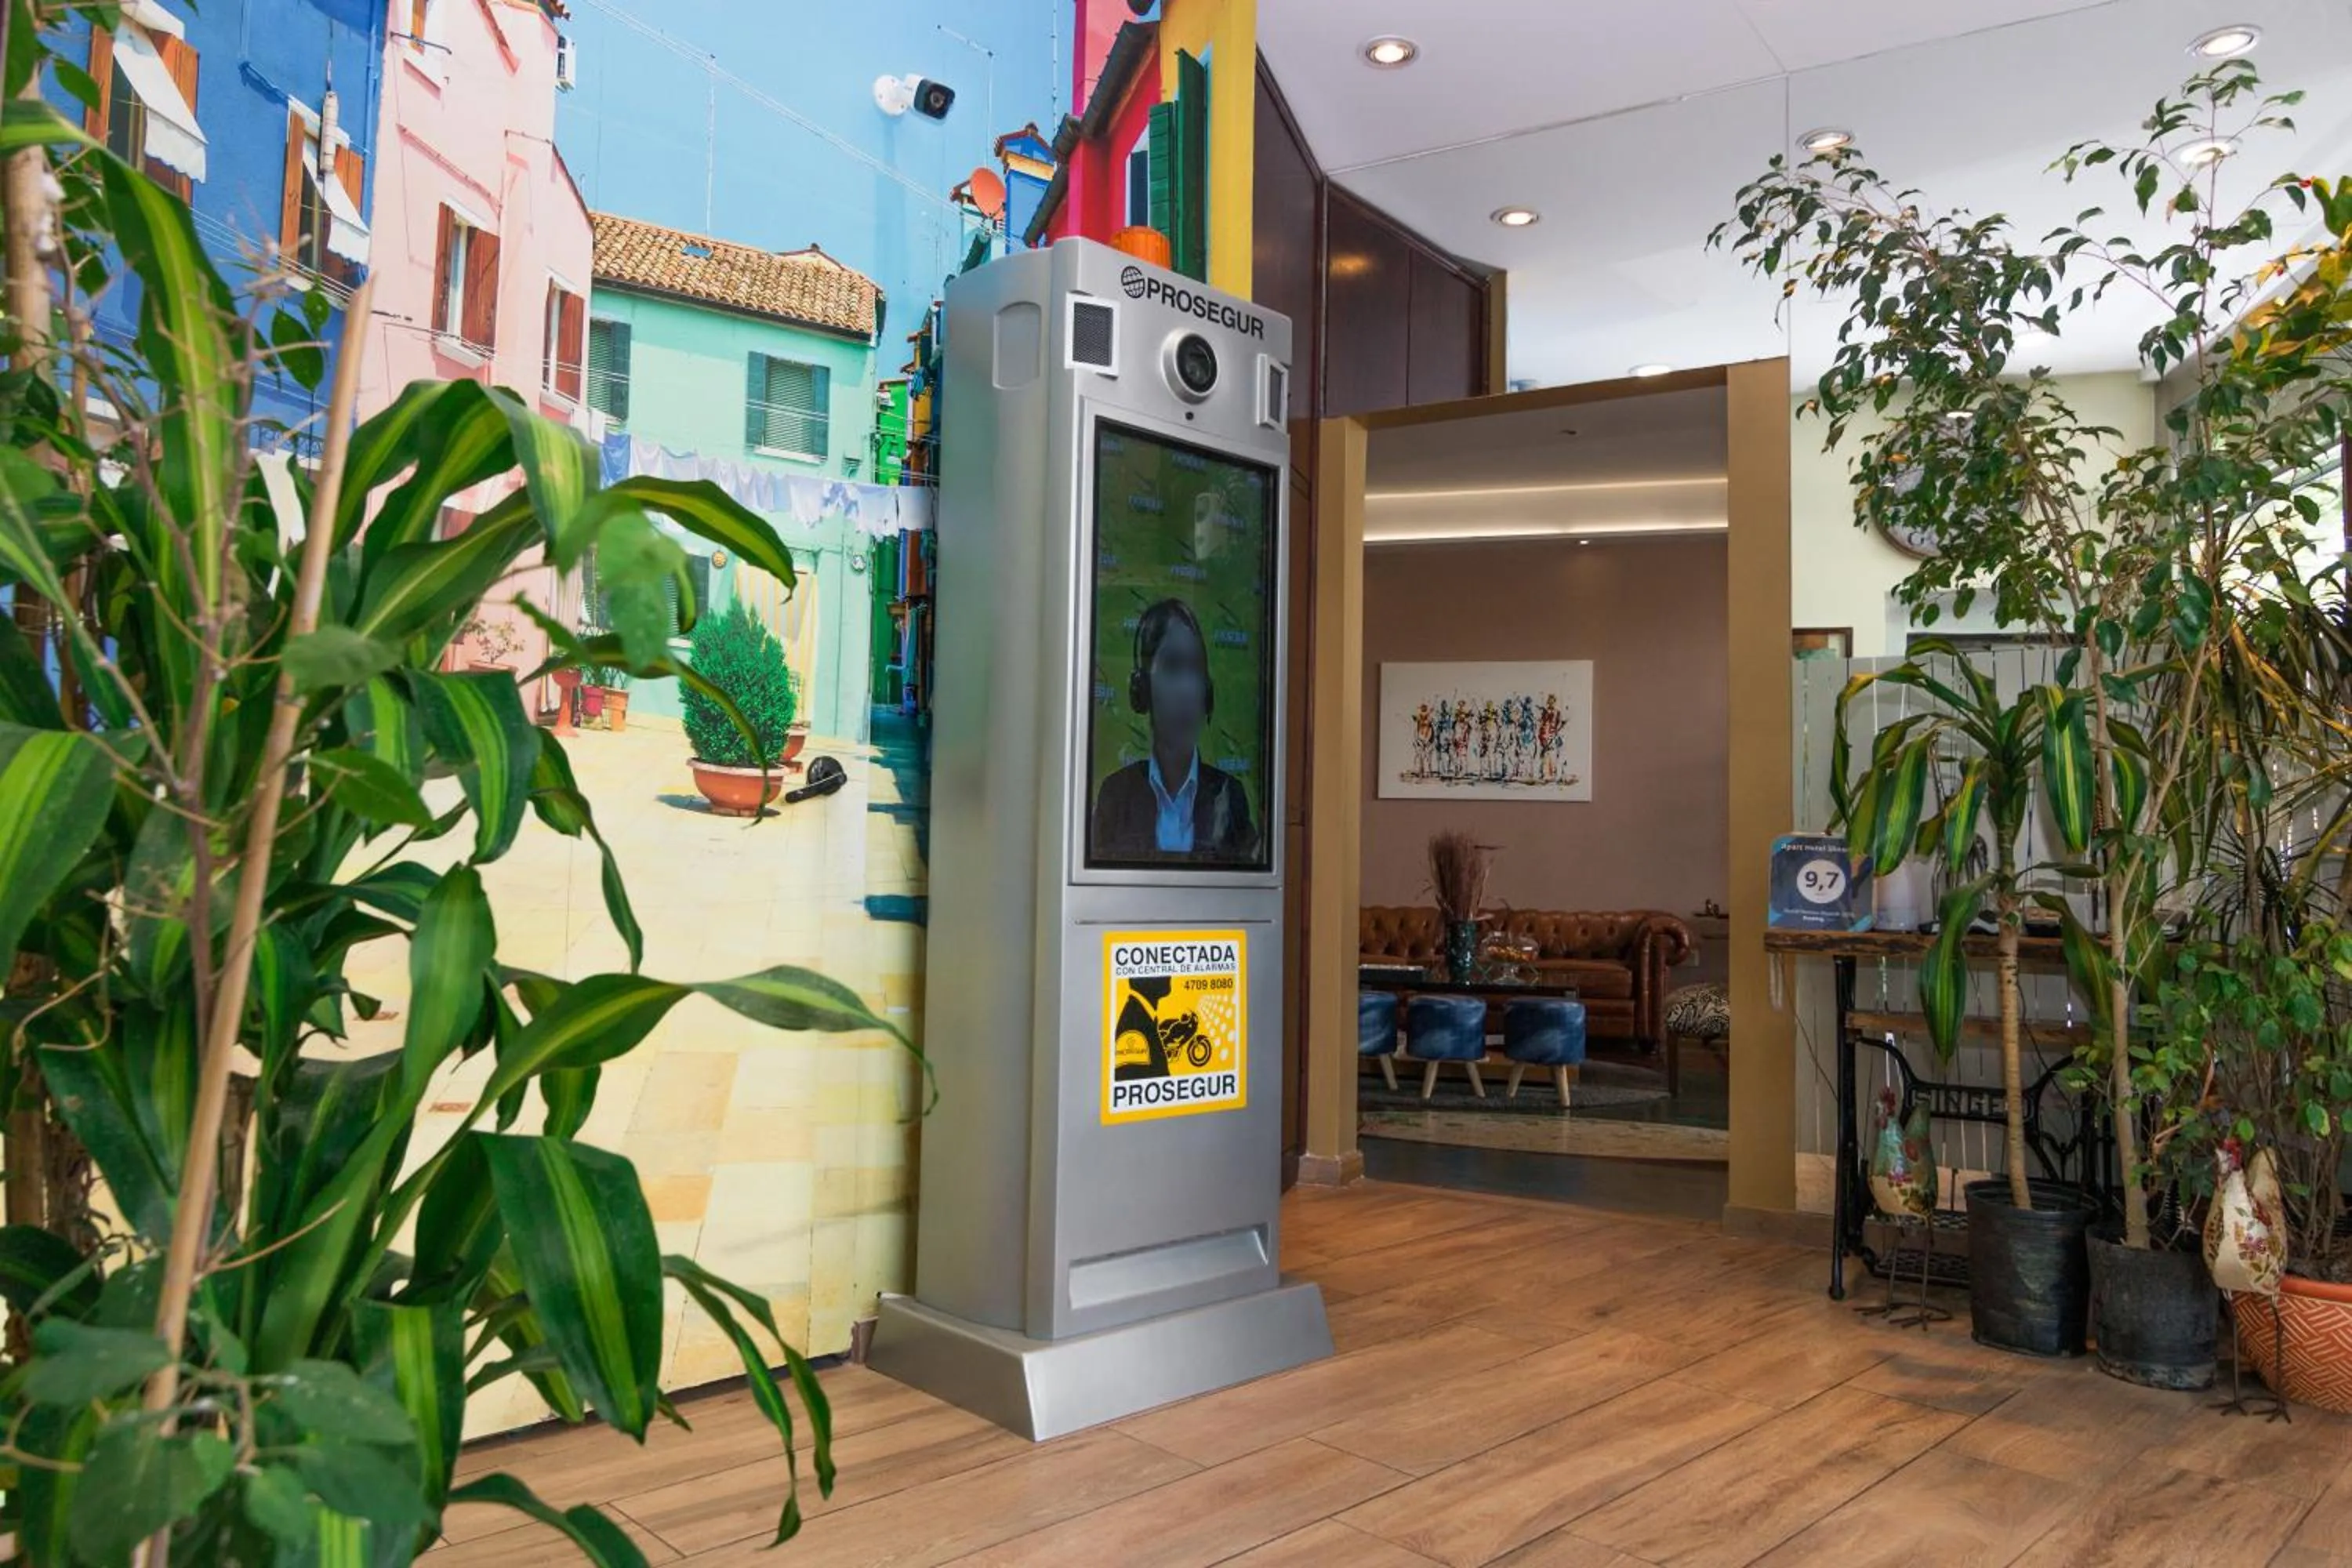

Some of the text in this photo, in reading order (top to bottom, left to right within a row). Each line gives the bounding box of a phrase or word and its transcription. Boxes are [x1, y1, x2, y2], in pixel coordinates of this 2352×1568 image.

[1147, 277, 1265, 340] PROSEGUR
[1805, 871, 1839, 891] 9,7
[1116, 945, 1236, 966] CONECTADA
[1116, 962, 1236, 976] CON CENTRAL DE ALARMAS
[1184, 979, 1208, 991] 4709
[1113, 1074, 1236, 1107] PROSEGUR
[1913, 1088, 2009, 1119] SINGE
